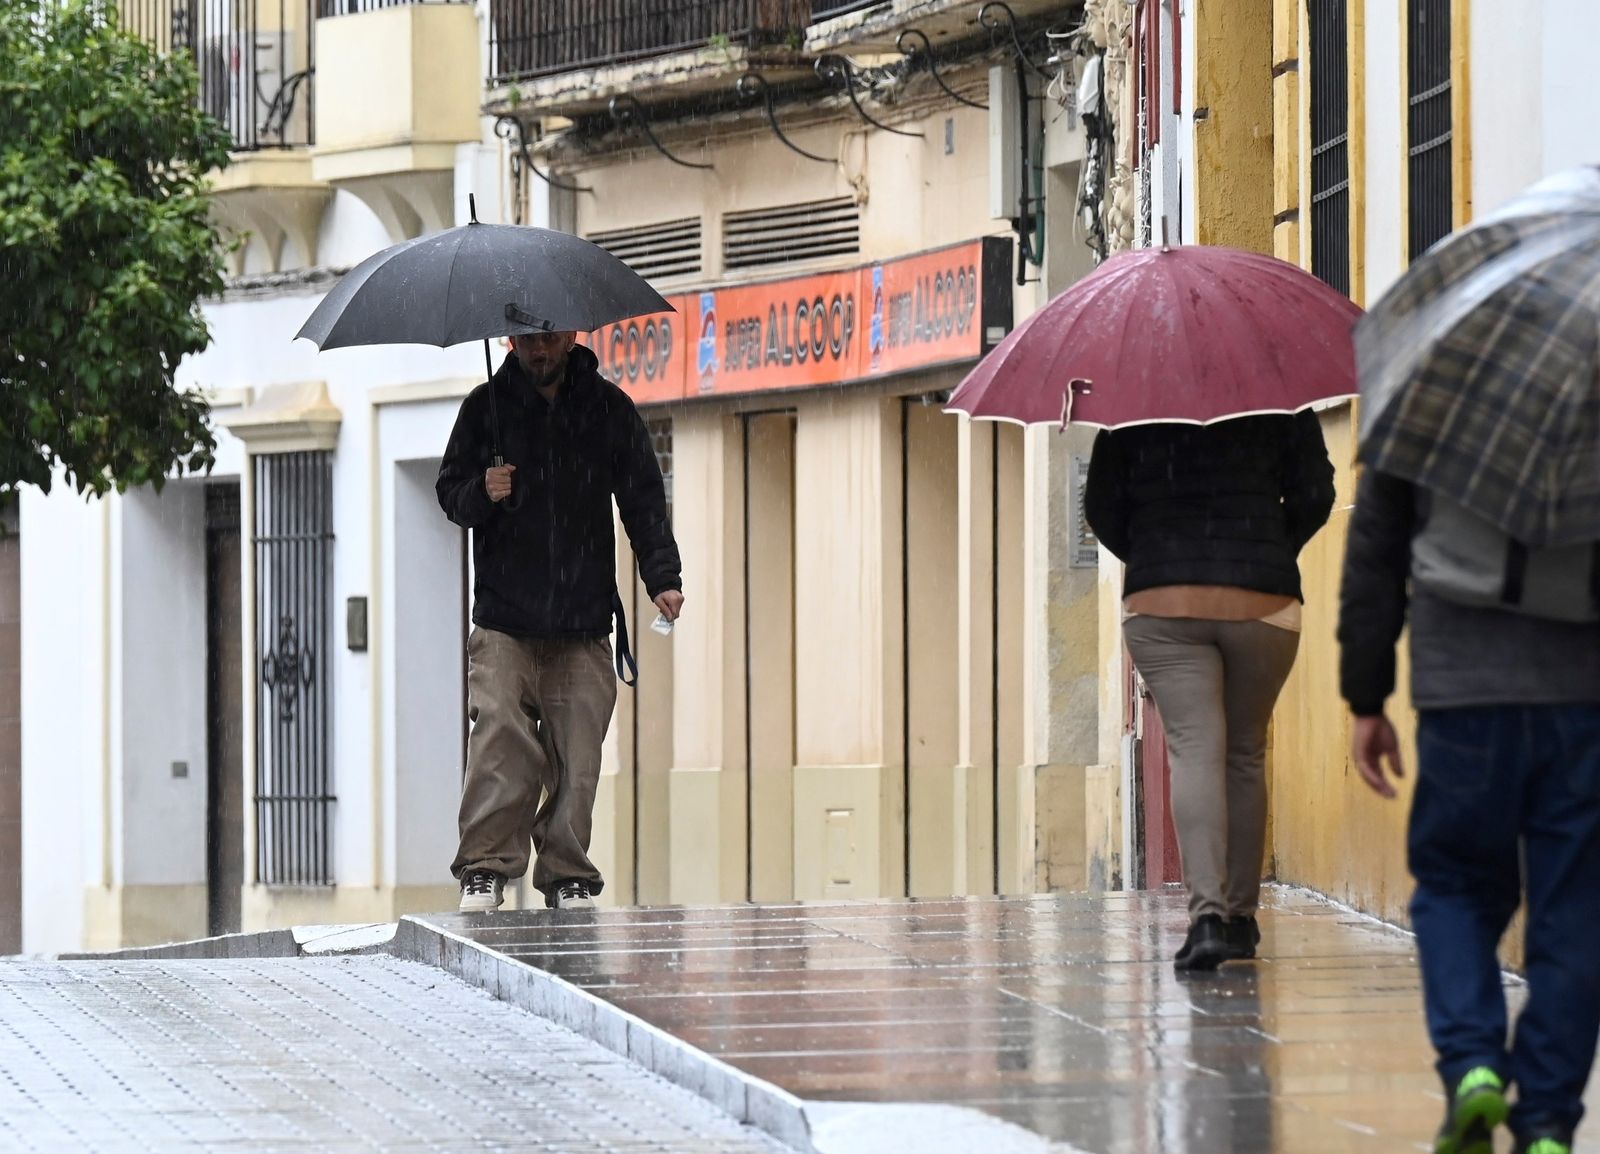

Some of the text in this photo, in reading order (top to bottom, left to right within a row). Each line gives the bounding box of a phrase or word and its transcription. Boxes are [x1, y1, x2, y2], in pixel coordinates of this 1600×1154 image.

[764, 293, 855, 367] ALCOOP
[913, 265, 976, 343] ALCOOP
[585, 317, 671, 385] LCOOP
